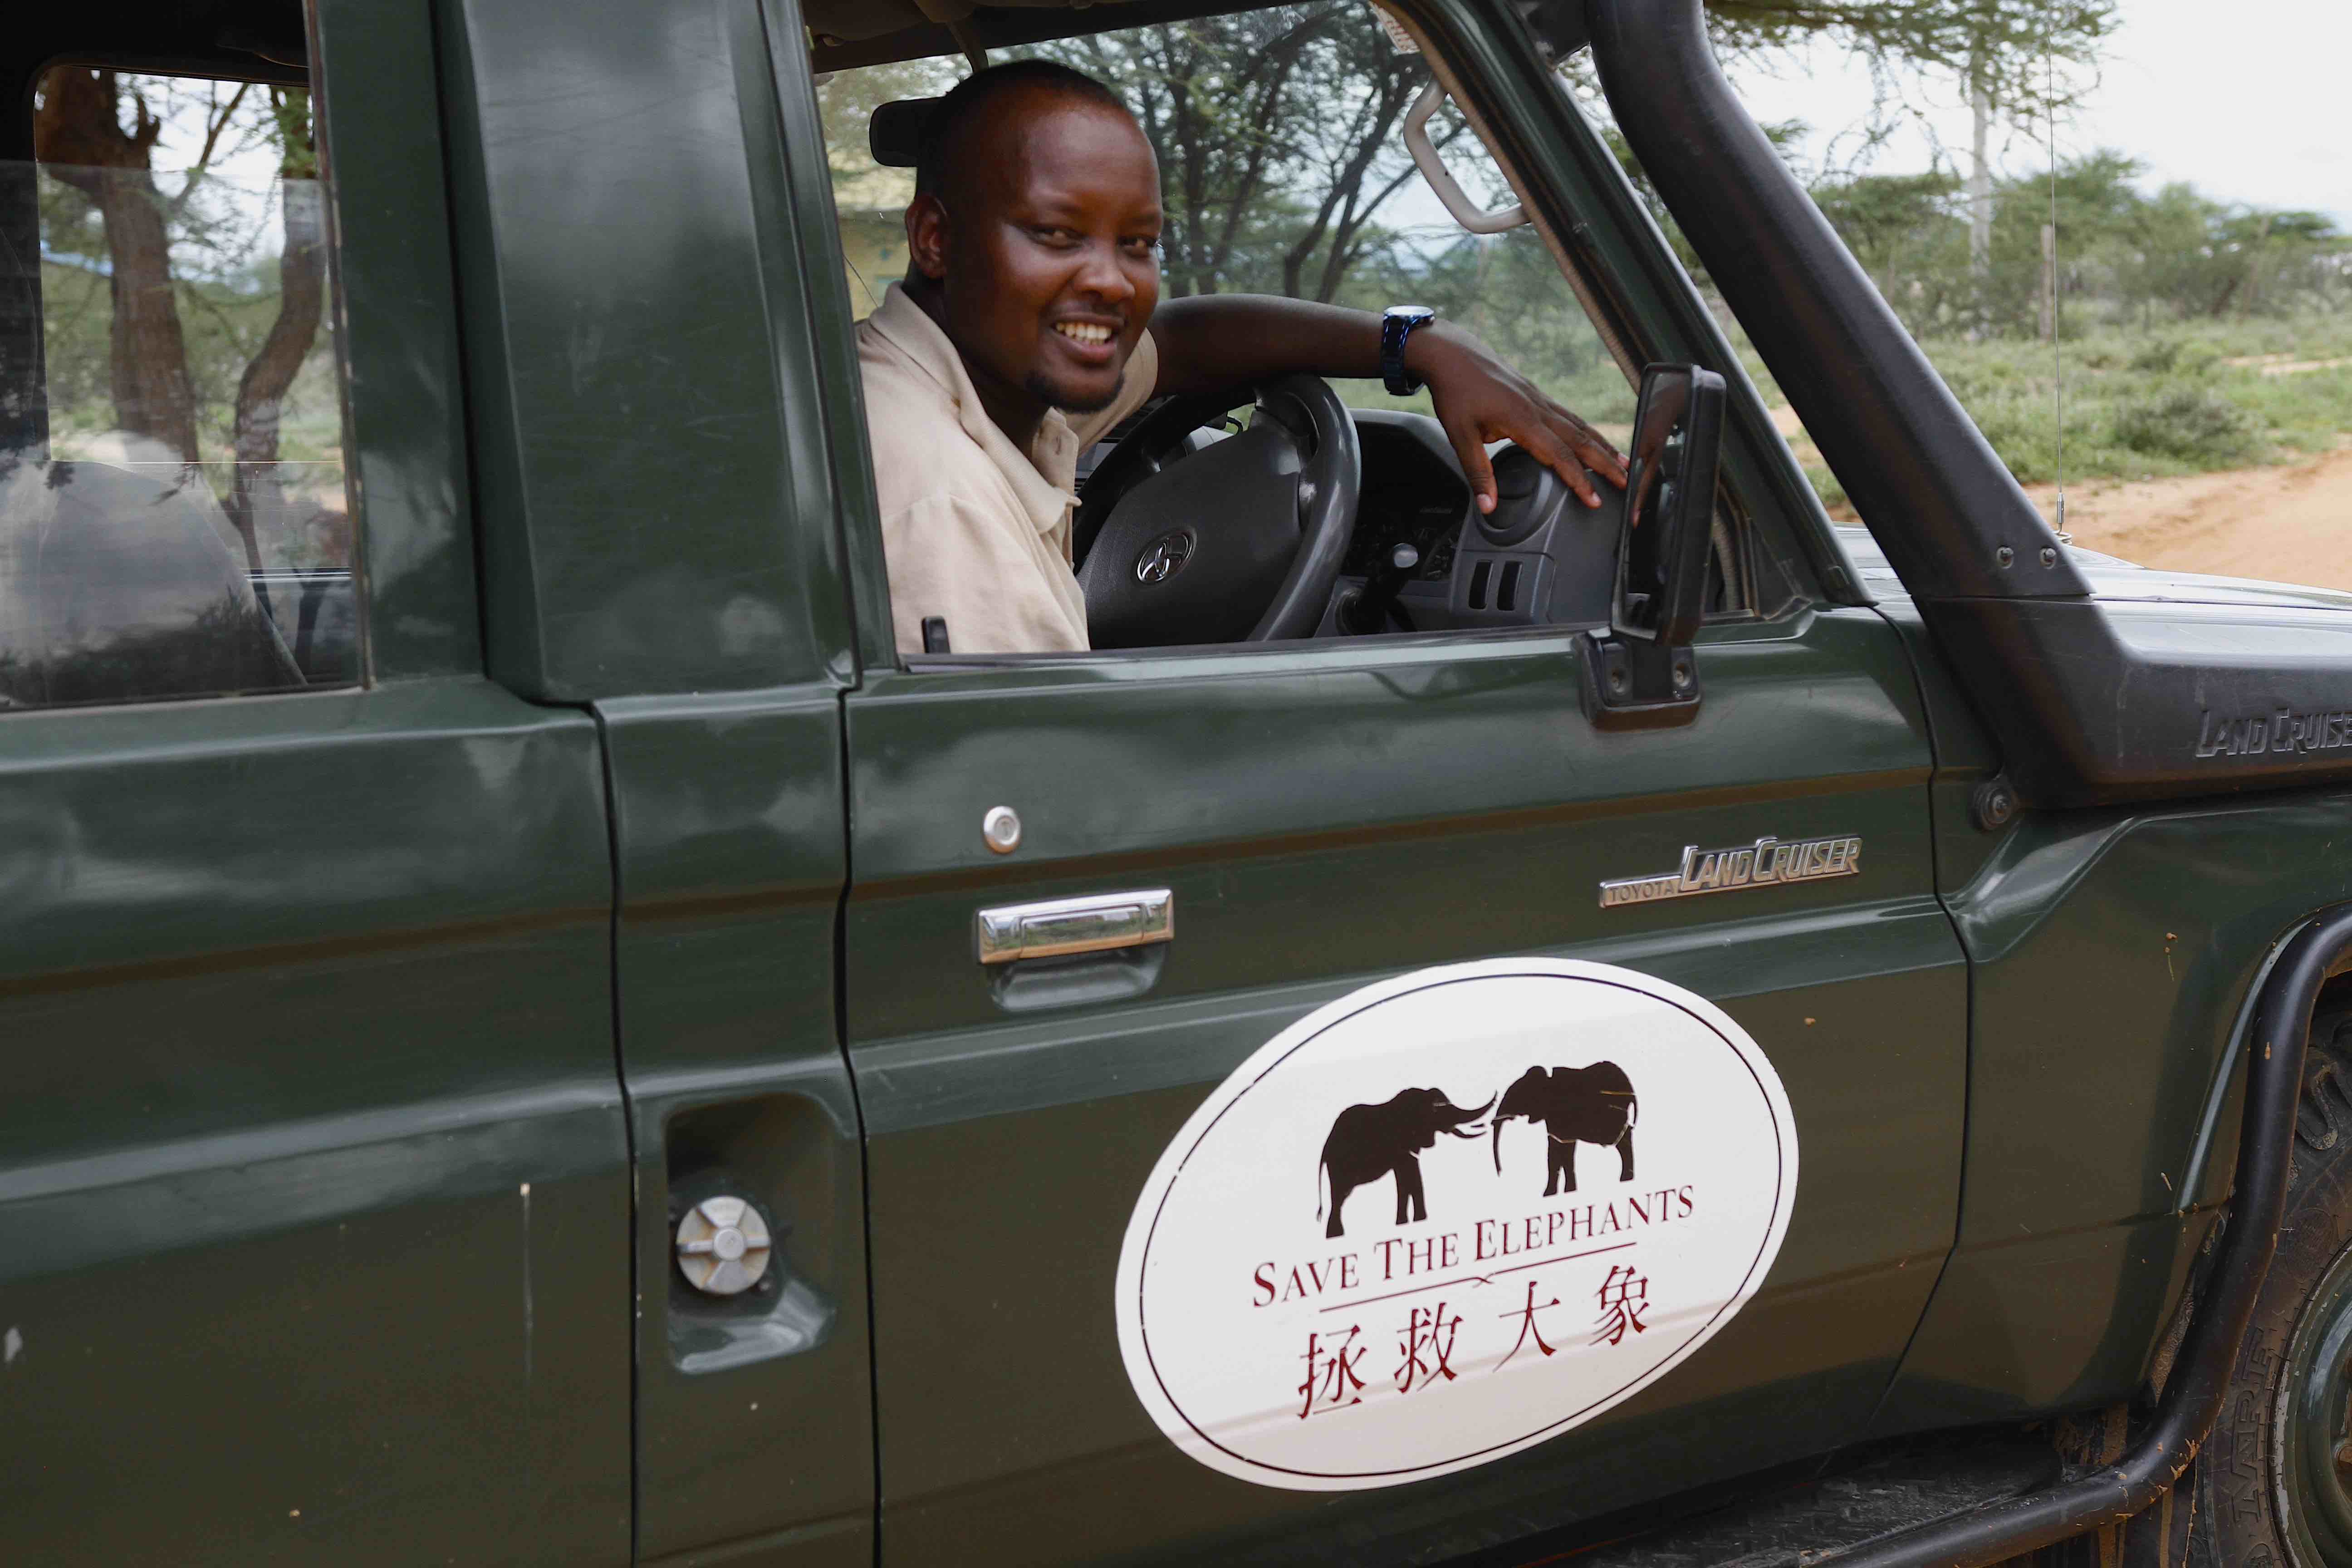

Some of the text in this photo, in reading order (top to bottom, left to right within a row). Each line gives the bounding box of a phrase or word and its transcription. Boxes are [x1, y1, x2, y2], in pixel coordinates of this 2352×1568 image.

[2196, 709, 2268, 757] LAND
[1609, 836, 1862, 902] TOYOTA LAND CRUISER
[1252, 1185, 1694, 1308] SAVE THE ELEPHANTS
[1298, 1264, 1649, 1419] 拯救大象
